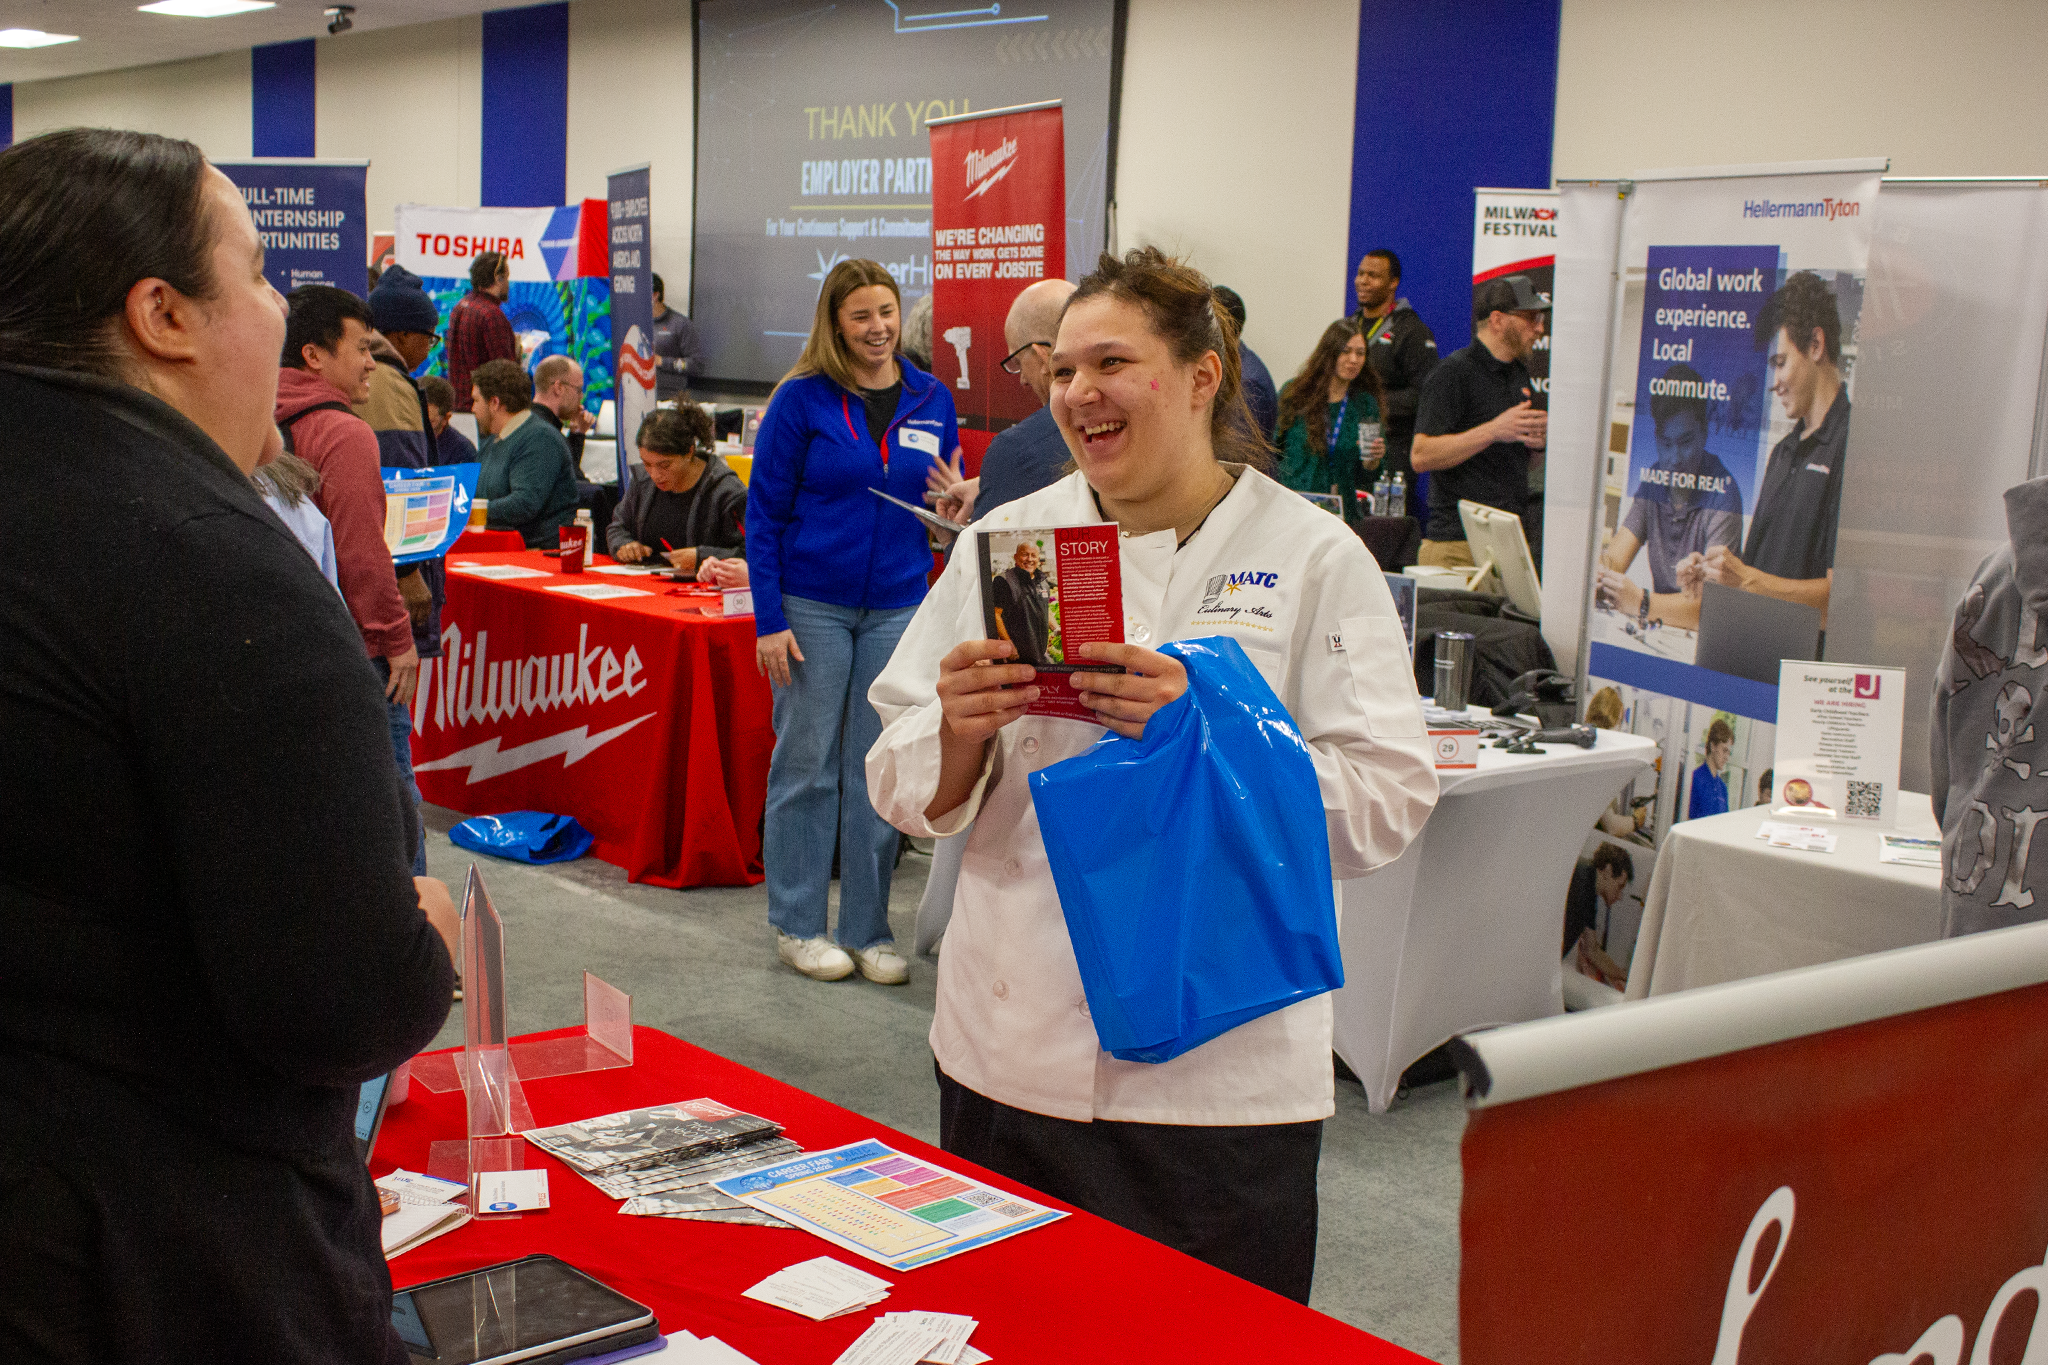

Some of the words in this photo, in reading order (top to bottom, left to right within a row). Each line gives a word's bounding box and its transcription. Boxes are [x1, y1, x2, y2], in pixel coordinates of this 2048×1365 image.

[804, 102, 896, 140] THANK
[801, 158, 880, 195] EMPLOYER
[1744, 198, 1859, 221] HellermannTyton
[935, 228, 976, 247] WE'RE
[978, 223, 1044, 245] CHANGING
[1483, 222, 1557, 237] FESTIVAL
[260, 232, 340, 250] RTUNITIES
[416, 232, 524, 260] TOSHIBA
[935, 249, 951, 261] THE
[953, 248, 971, 260] WAY
[973, 247, 996, 260] WORK
[997, 246, 1019, 259] GETS
[1020, 245, 1044, 258] DONE
[291, 269, 323, 278] Human
[935, 264, 953, 279] ON
[956, 262, 993, 279] EVERY
[995, 261, 1044, 279] JOBSITE
[1659, 267, 1712, 292] Global
[1717, 268, 1763, 292] work
[1656, 304, 1751, 331] experience.
[1653, 338, 1693, 362] Local
[1649, 378, 1731, 401] commute.
[1640, 467, 1670, 486] MADE
[1672, 471, 1696, 489] FOR
[1060, 540, 1109, 556] STORY
[1228, 571, 1278, 589] MATC
[1197, 601, 1242, 619] Culinary
[1244, 606, 1273, 618] Arts
[413, 621, 647, 738] Milwaukee
[1818, 677, 1853, 686] yourself
[1838, 686, 1853, 694] the
[1442, 744, 1454, 753] 29
[767, 1162, 808, 1178] CAREER
[808, 1157, 833, 1168] FAIR
[785, 1169, 814, 1180] SPRING
